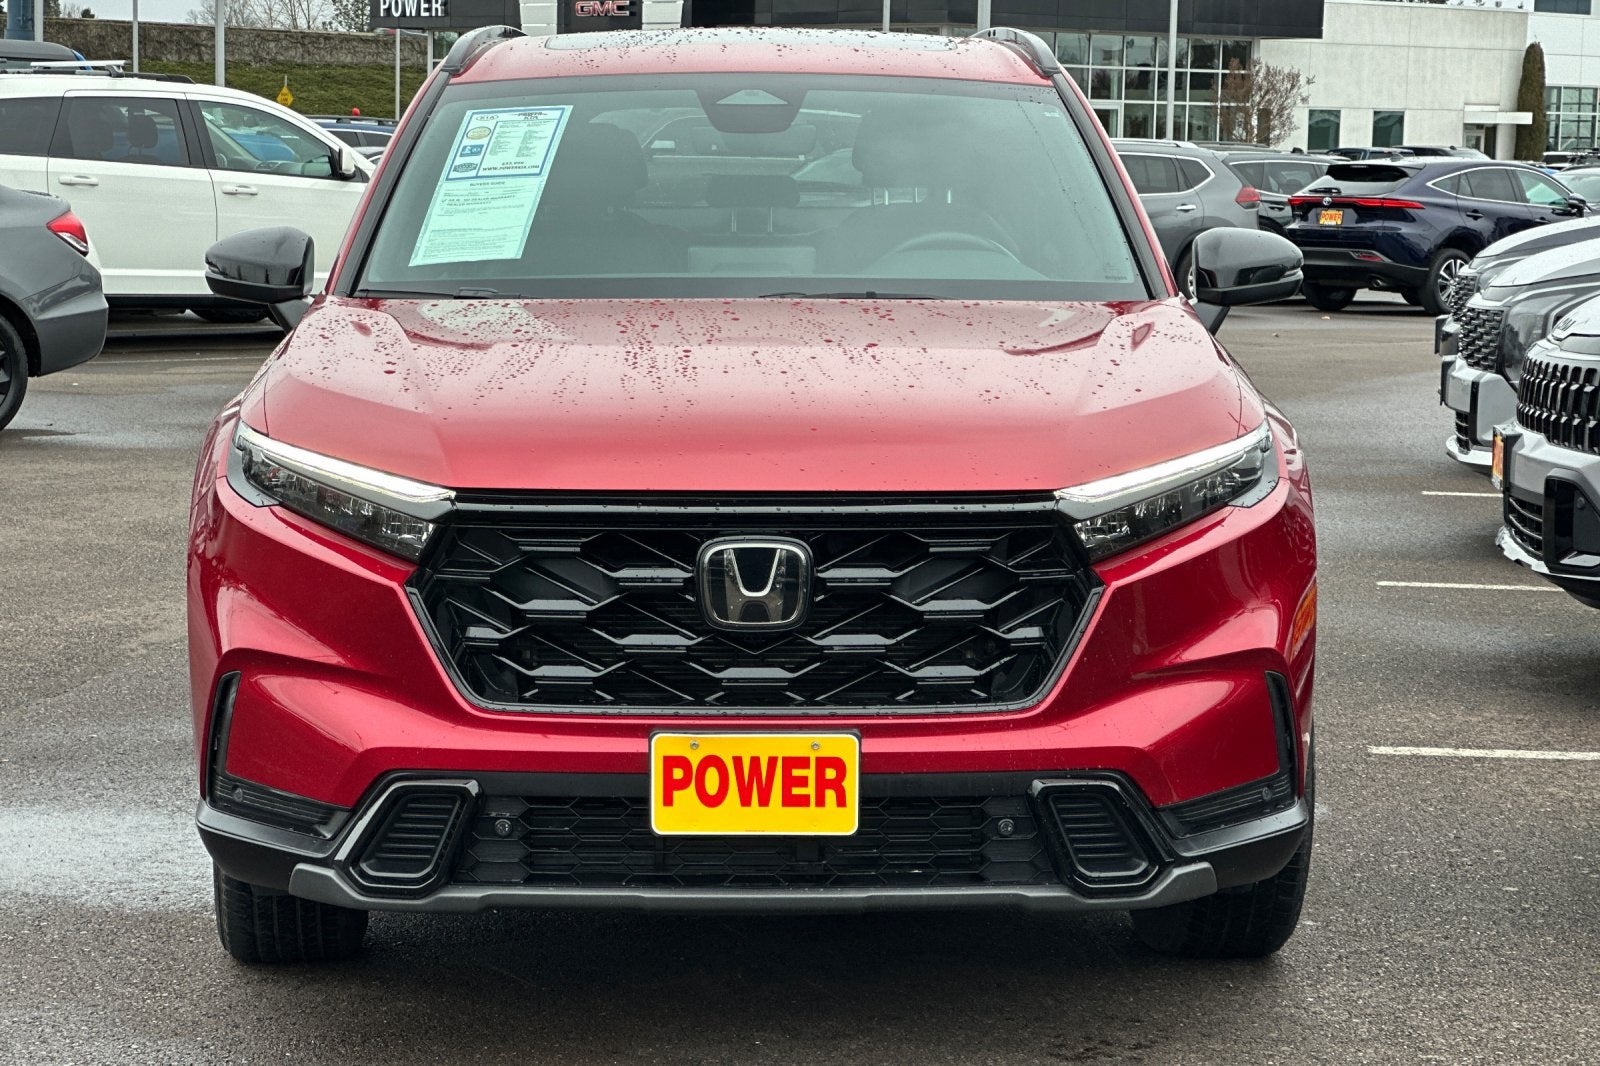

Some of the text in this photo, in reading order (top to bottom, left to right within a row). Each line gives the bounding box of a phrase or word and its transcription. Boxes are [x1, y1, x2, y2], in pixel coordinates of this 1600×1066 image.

[380, 0, 443, 17] POWER
[575, 0, 630, 17] GMC
[1320, 212, 1342, 220] POWER
[663, 754, 847, 808] POWER
